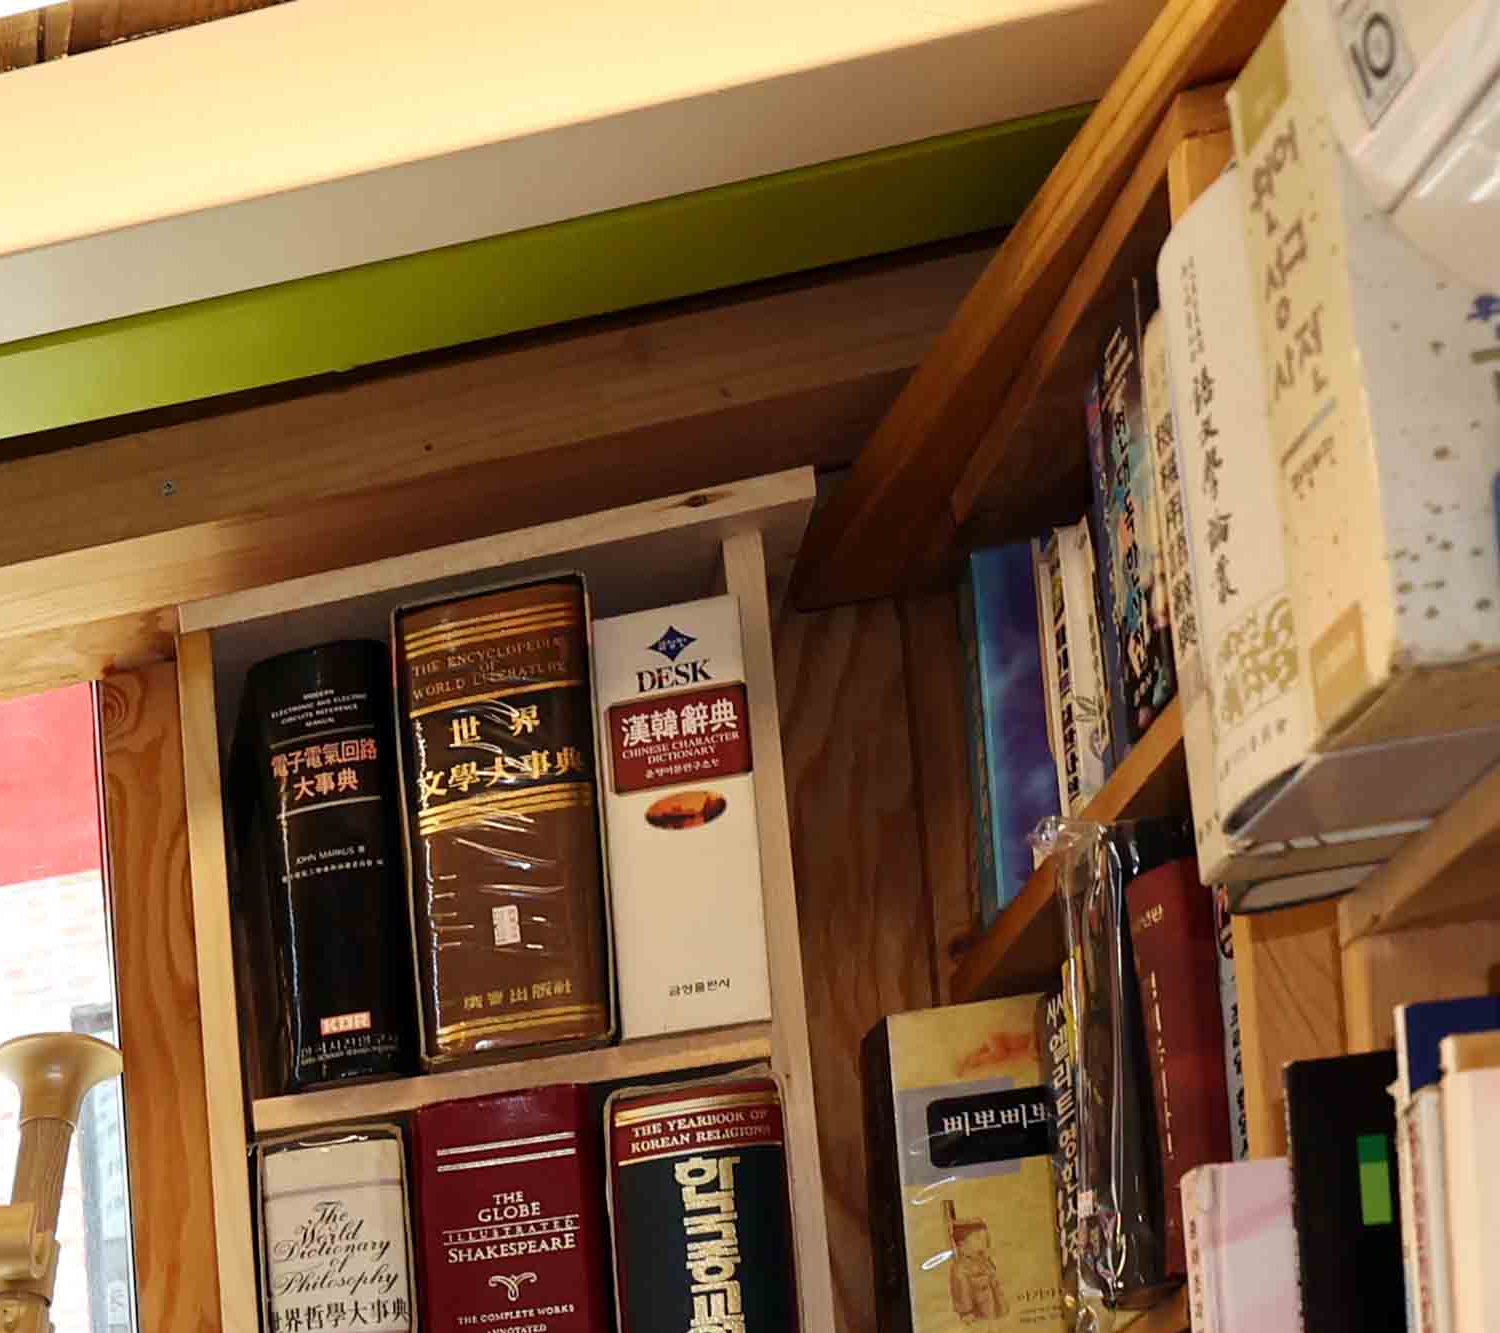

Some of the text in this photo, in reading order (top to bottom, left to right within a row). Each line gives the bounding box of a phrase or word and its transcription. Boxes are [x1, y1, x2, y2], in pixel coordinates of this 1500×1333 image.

[412, 677, 464, 700] WORLD
[635, 658, 713, 693] DESK
[449, 703, 541, 747] 世界
[622, 731, 741, 761] CHINESE CHARACTER
[646, 745, 718, 766] DICTIONARY
[293, 766, 360, 801] 大事典
[631, 1107, 769, 1138] THE YEARBOOK OF
[630, 1123, 772, 1155] KOREAN RELIGIONS
[492, 1189, 525, 1206] THE
[477, 1201, 541, 1225] GLOBE
[294, 1219, 364, 1246] World
[444, 1216, 578, 1244] ILLUSTRATED
[270, 1236, 392, 1267] Dictionary
[447, 1231, 577, 1265] SHAKESPEARE
[271, 1267, 401, 1300] Philosophy
[456, 1303, 575, 1327] THE COMPLETE WORKS
